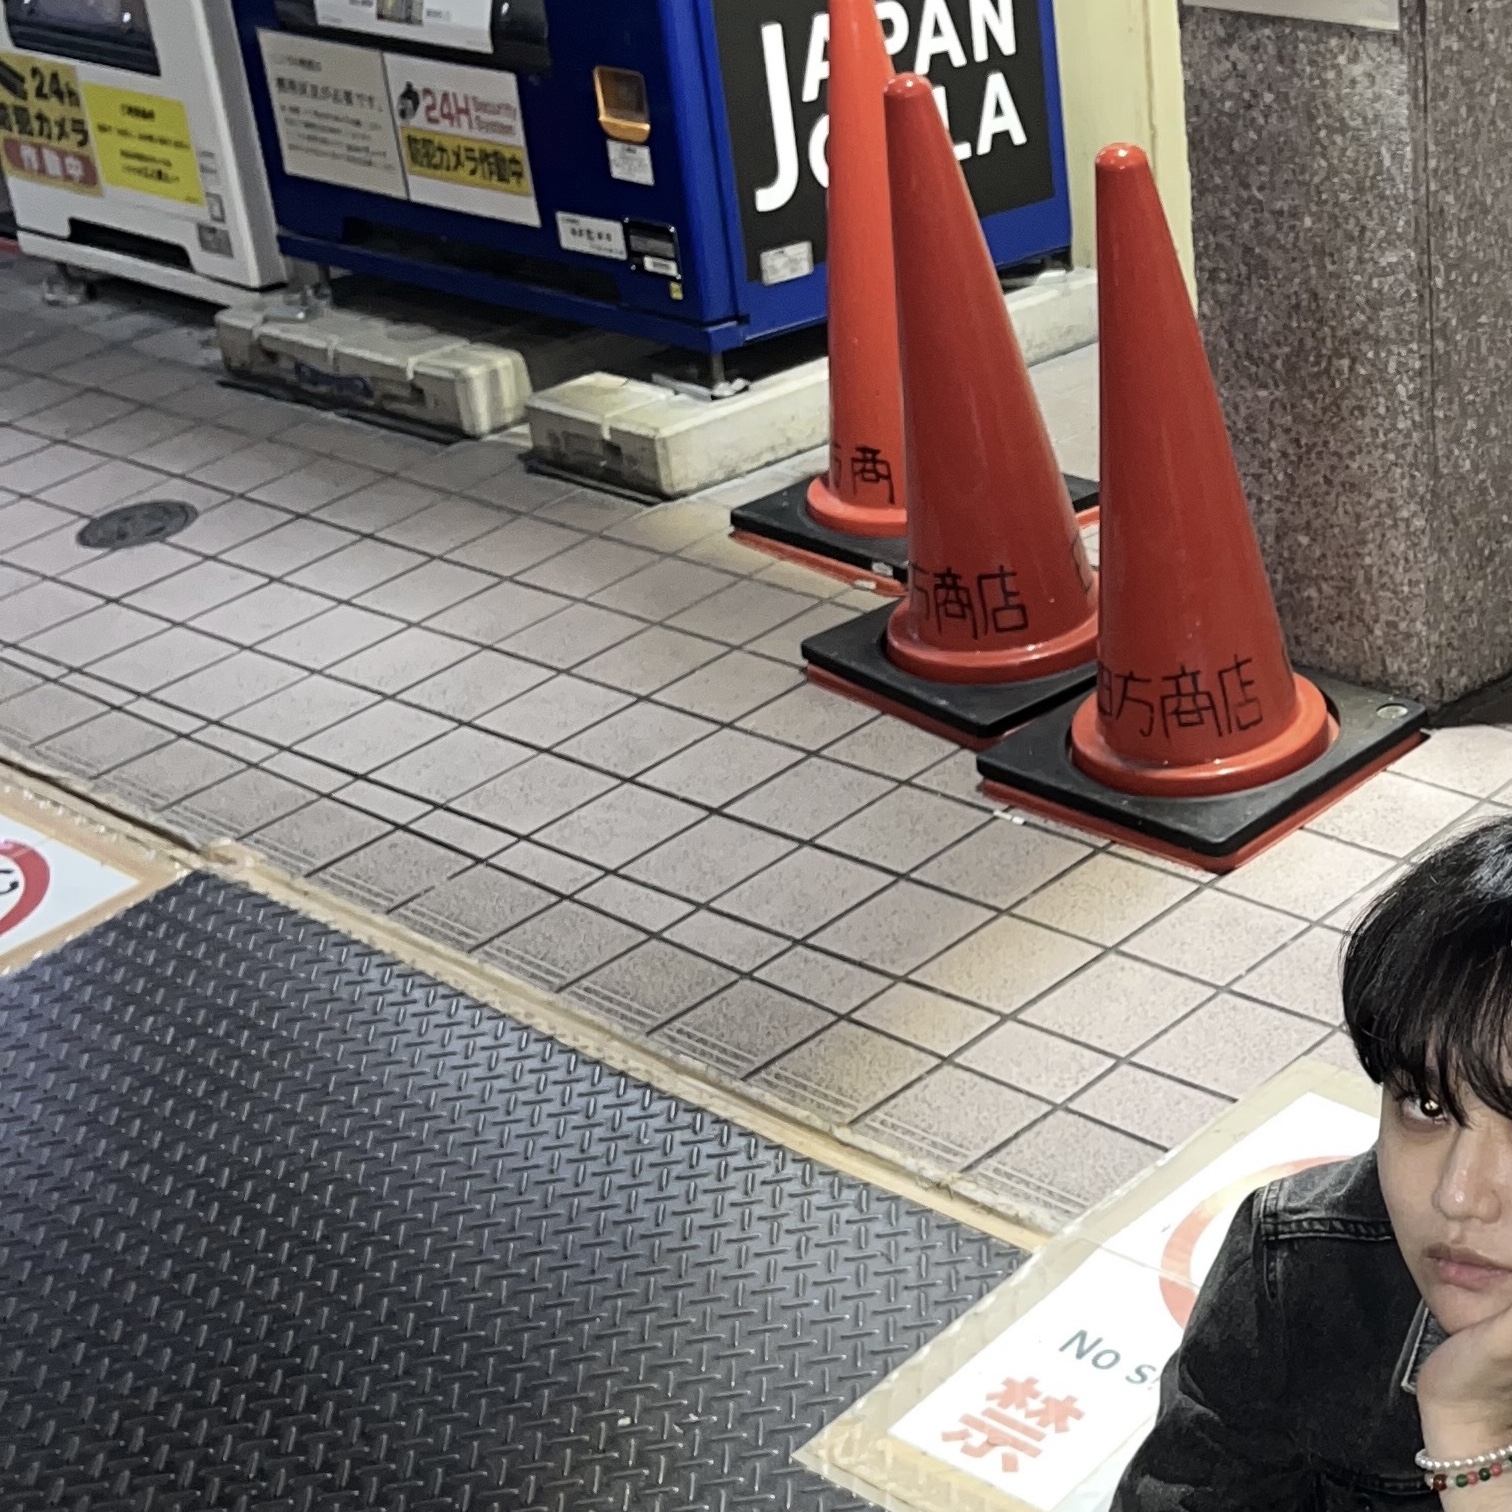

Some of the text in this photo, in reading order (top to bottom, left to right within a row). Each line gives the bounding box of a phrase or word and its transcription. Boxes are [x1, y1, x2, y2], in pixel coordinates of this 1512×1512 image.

[422, 87, 473, 131] 24H
[1059, 1328, 1122, 1371] No
[941, 1374, 1086, 1474] 禁
